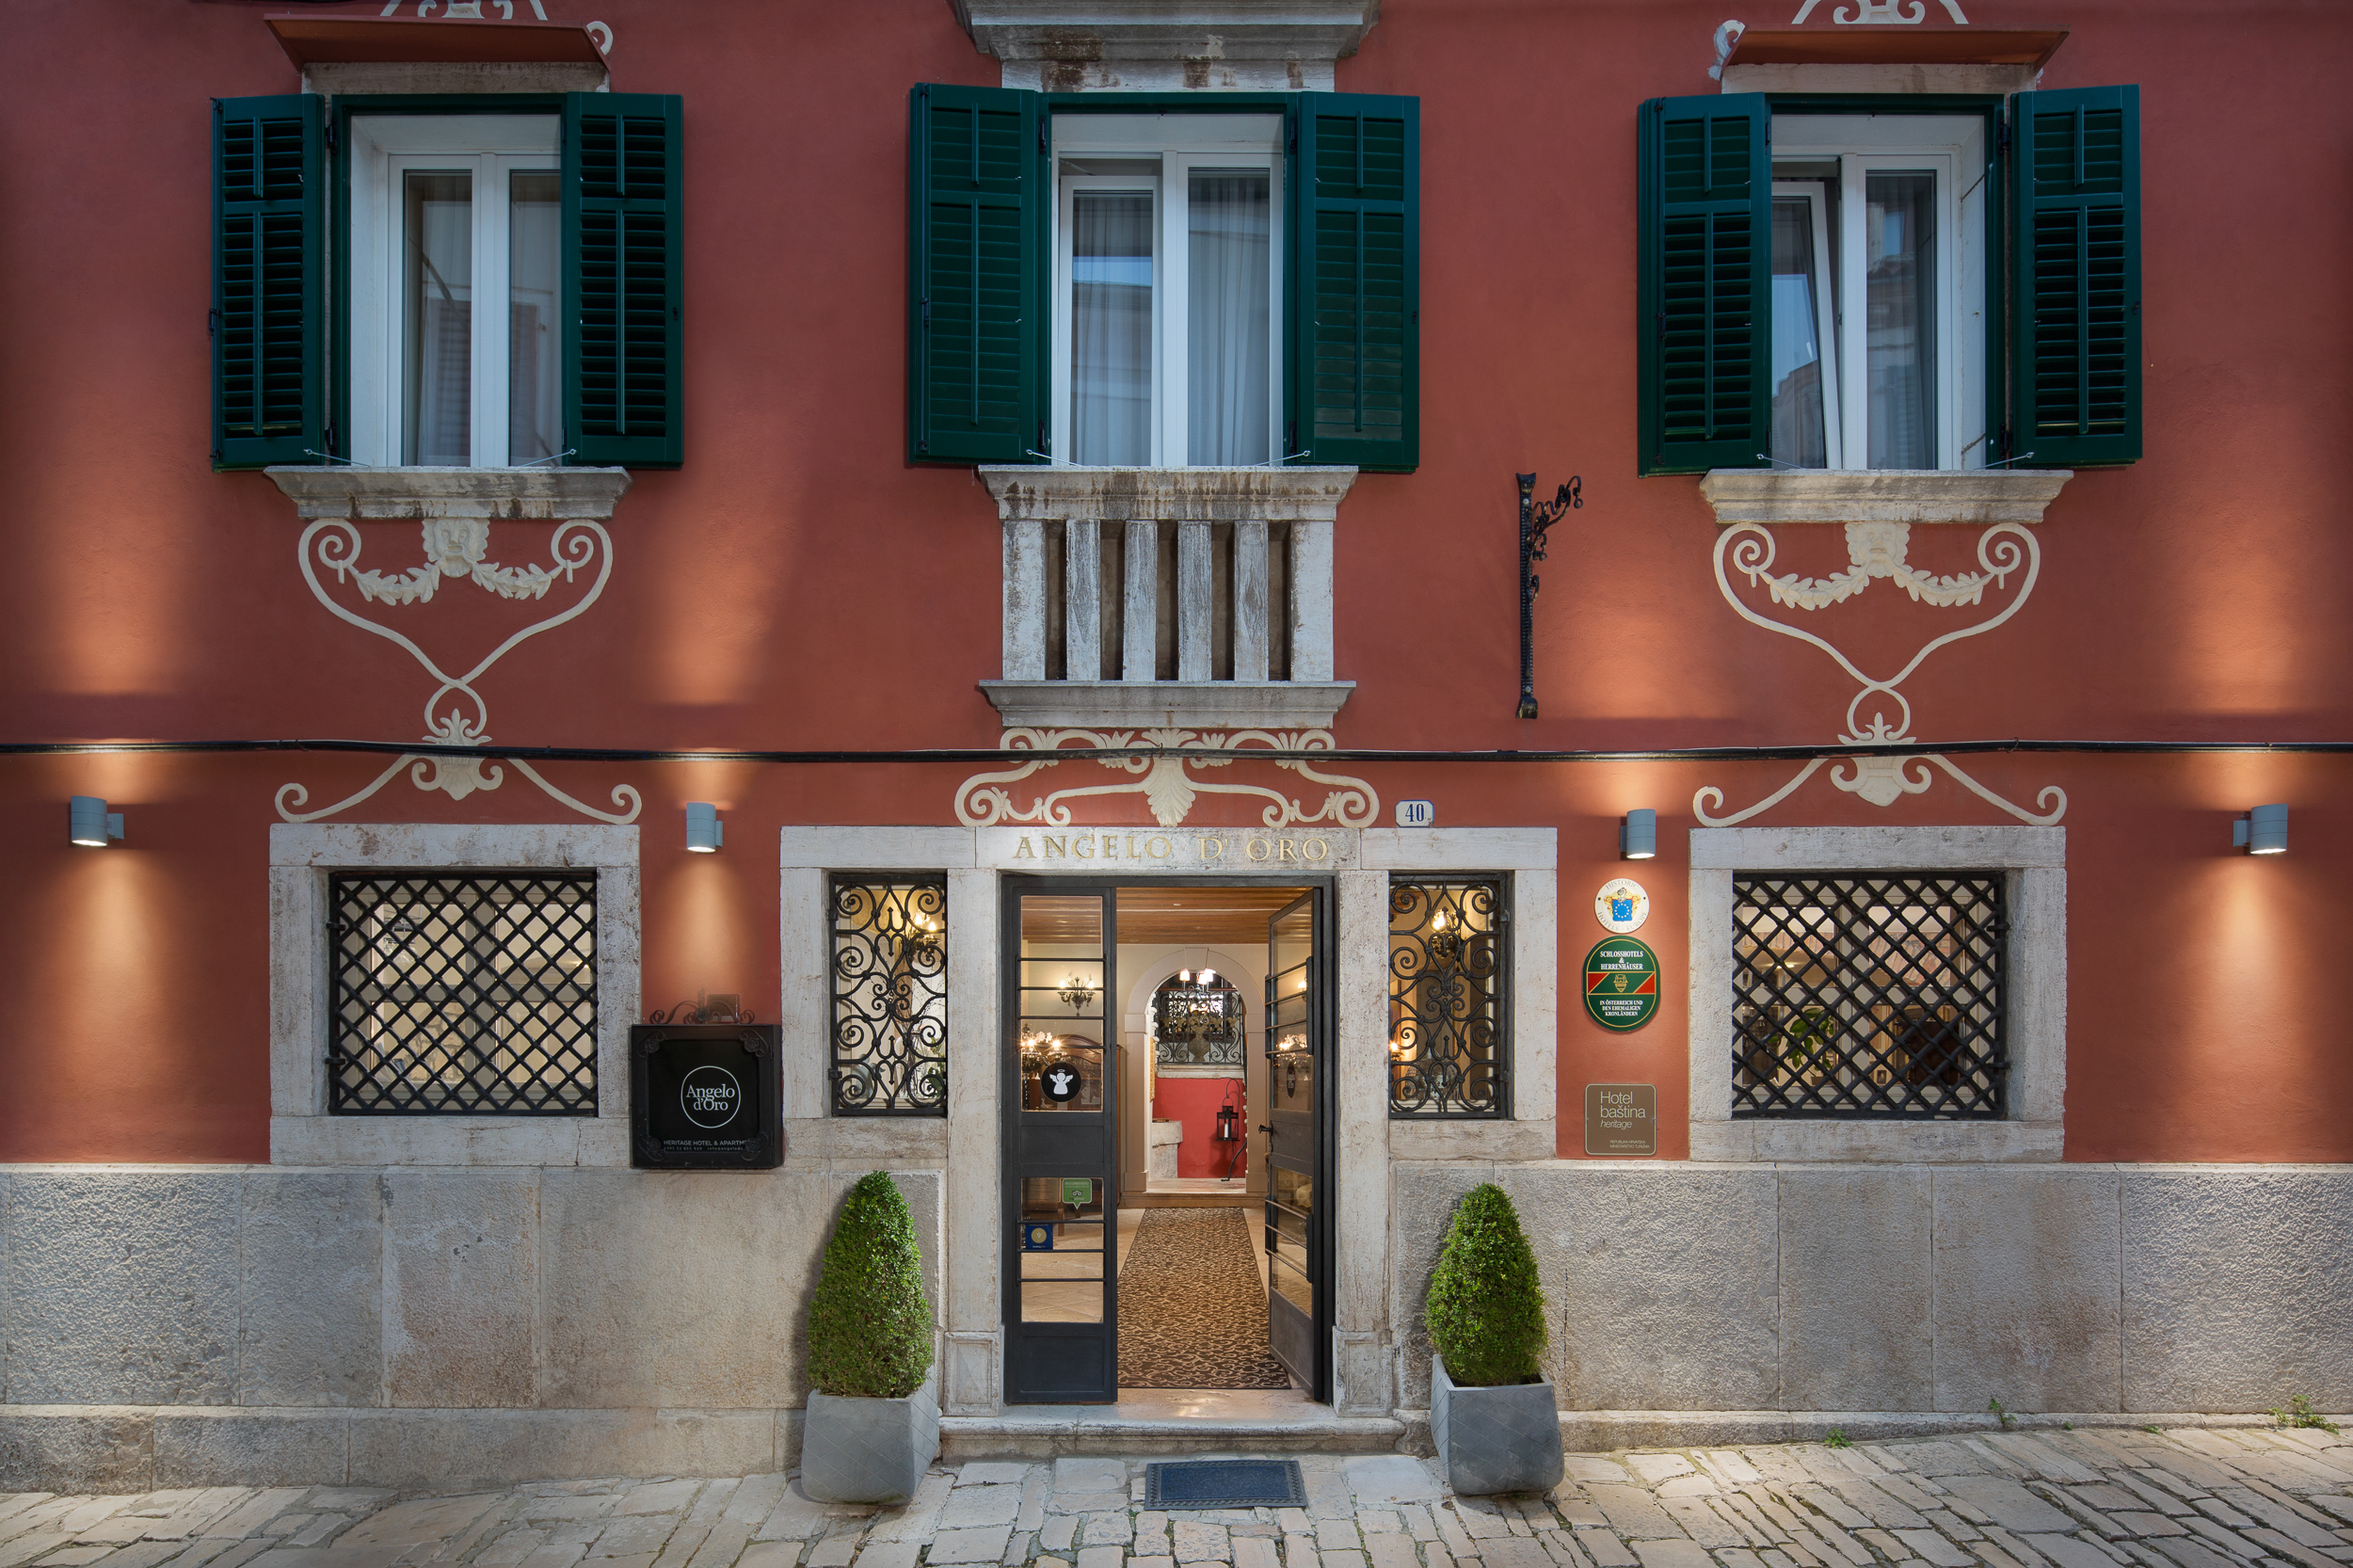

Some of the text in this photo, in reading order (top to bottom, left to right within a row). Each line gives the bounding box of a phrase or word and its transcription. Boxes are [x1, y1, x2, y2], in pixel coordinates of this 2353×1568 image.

[1405, 804, 1424, 822] 40
[1012, 835, 1173, 859] ANGELO
[1245, 838, 1328, 861] ORO
[1605, 879, 1640, 889] HISTORIC
[1597, 911, 1647, 932] HOTELS EUROPE
[685, 1083, 735, 1101] Angelo
[1600, 1091, 1633, 1104] Hotel
[693, 1097, 728, 1111] d'Oro
[1600, 1104, 1646, 1118] baština
[1600, 1119, 1633, 1130] heritage
